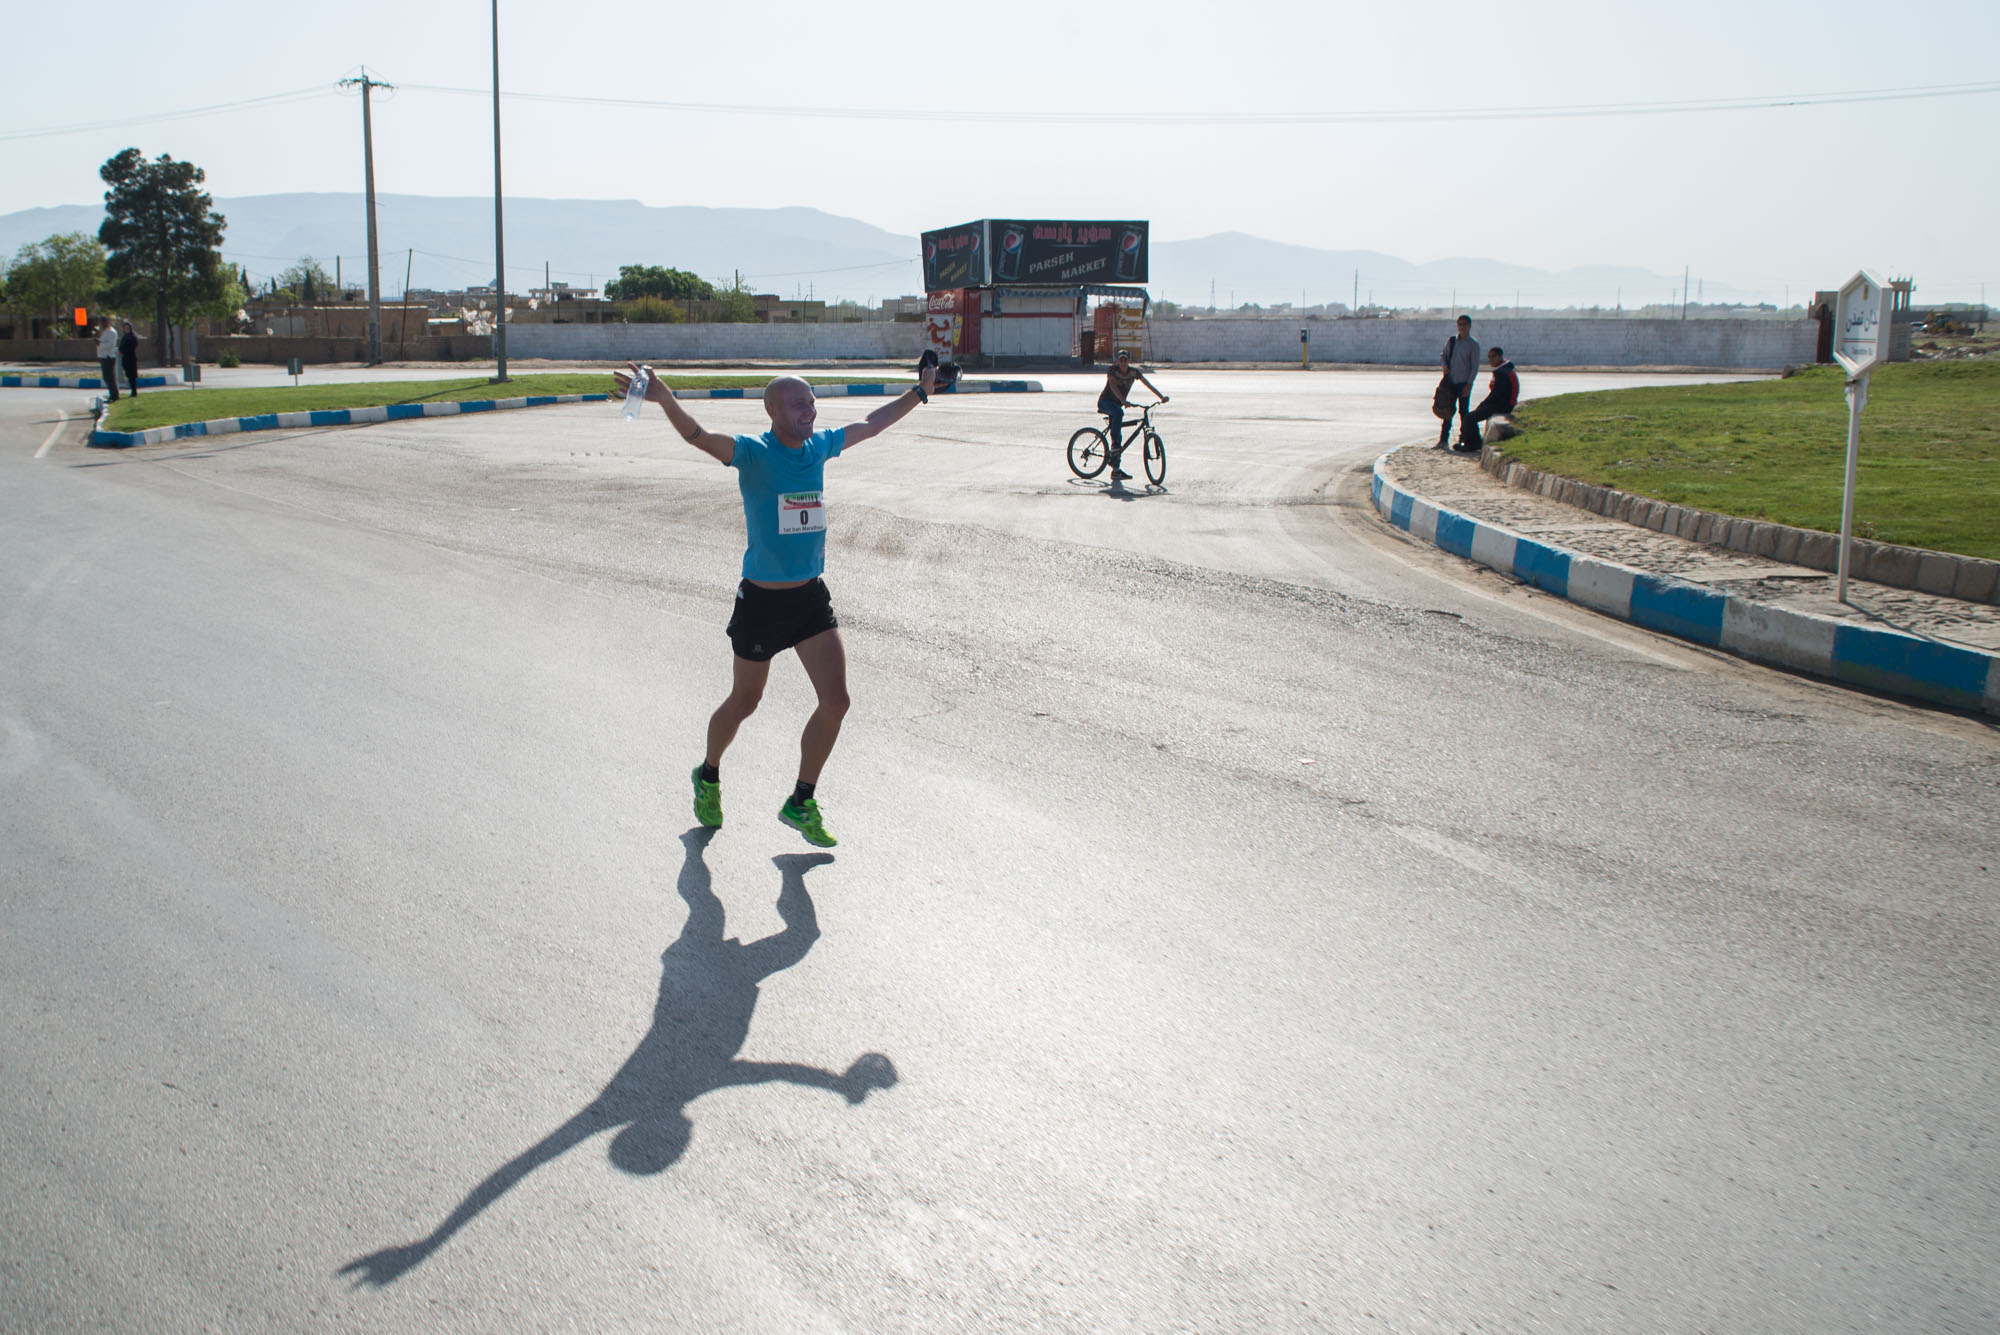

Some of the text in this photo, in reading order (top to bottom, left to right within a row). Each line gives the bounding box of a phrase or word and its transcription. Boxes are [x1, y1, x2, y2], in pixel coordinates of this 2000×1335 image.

[1032, 222, 1112, 244] سوپر پارسه
[1029, 251, 1075, 274] PARSEH
[1061, 257, 1107, 281] MARKET
[927, 317, 952, 348] یخ
[800, 509, 809, 526] 0
